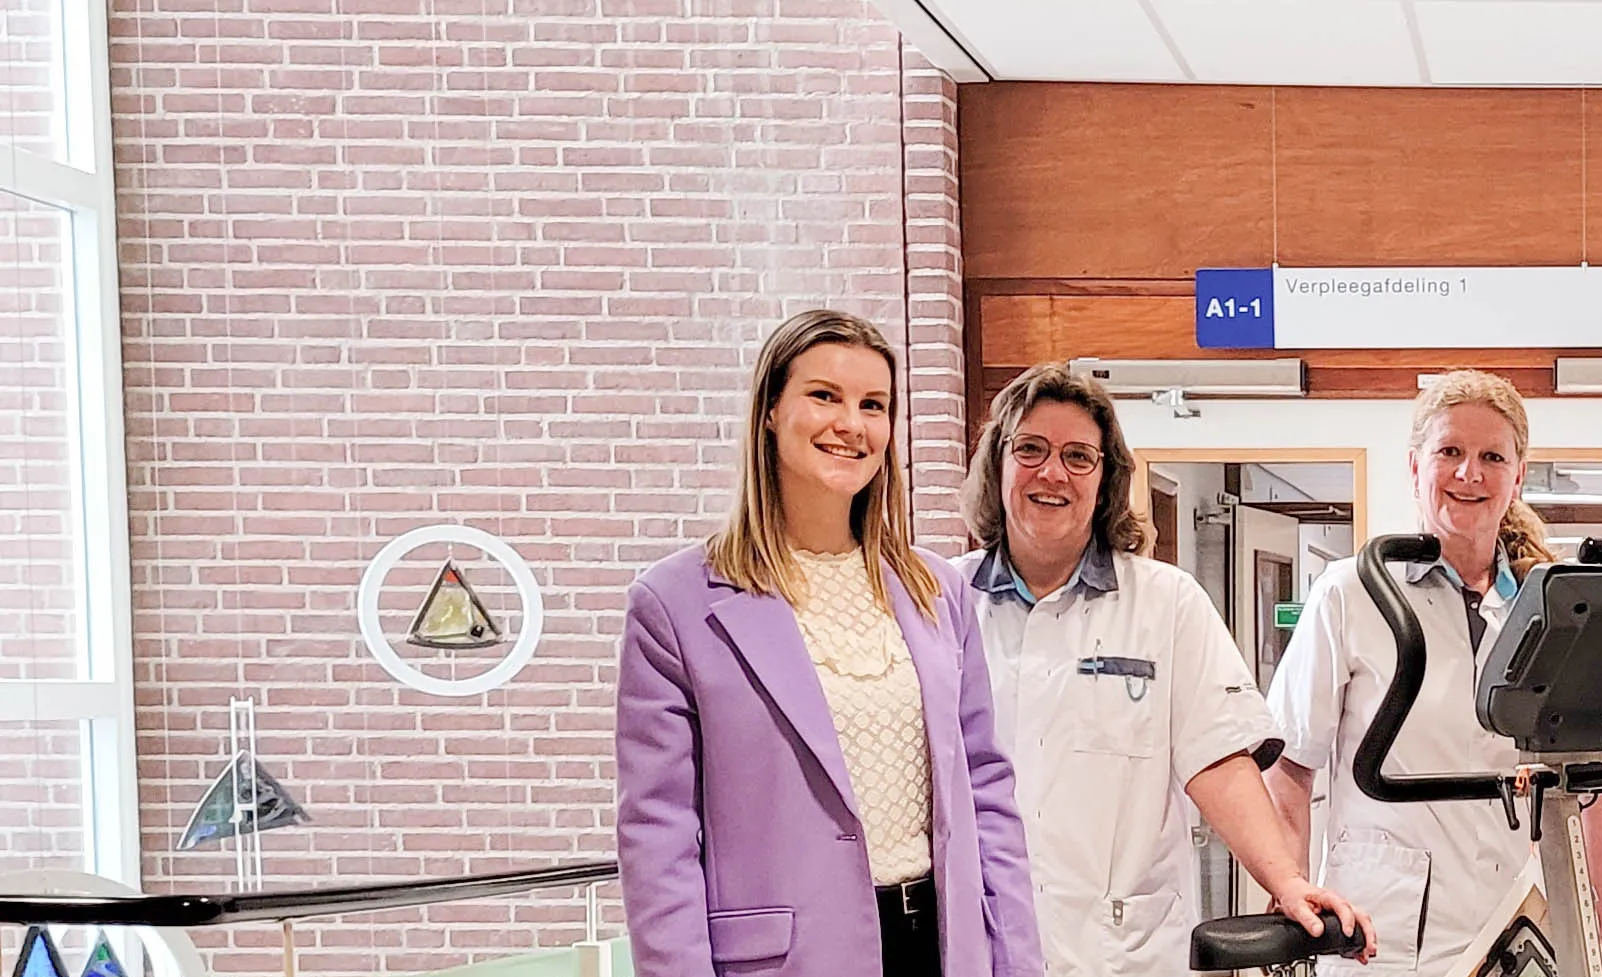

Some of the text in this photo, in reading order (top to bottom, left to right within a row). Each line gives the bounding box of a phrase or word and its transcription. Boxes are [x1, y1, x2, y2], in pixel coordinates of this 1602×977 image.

[1286, 277, 1466, 297] Verpleegafdeling 1
[1205, 297, 1262, 318] A1-1
